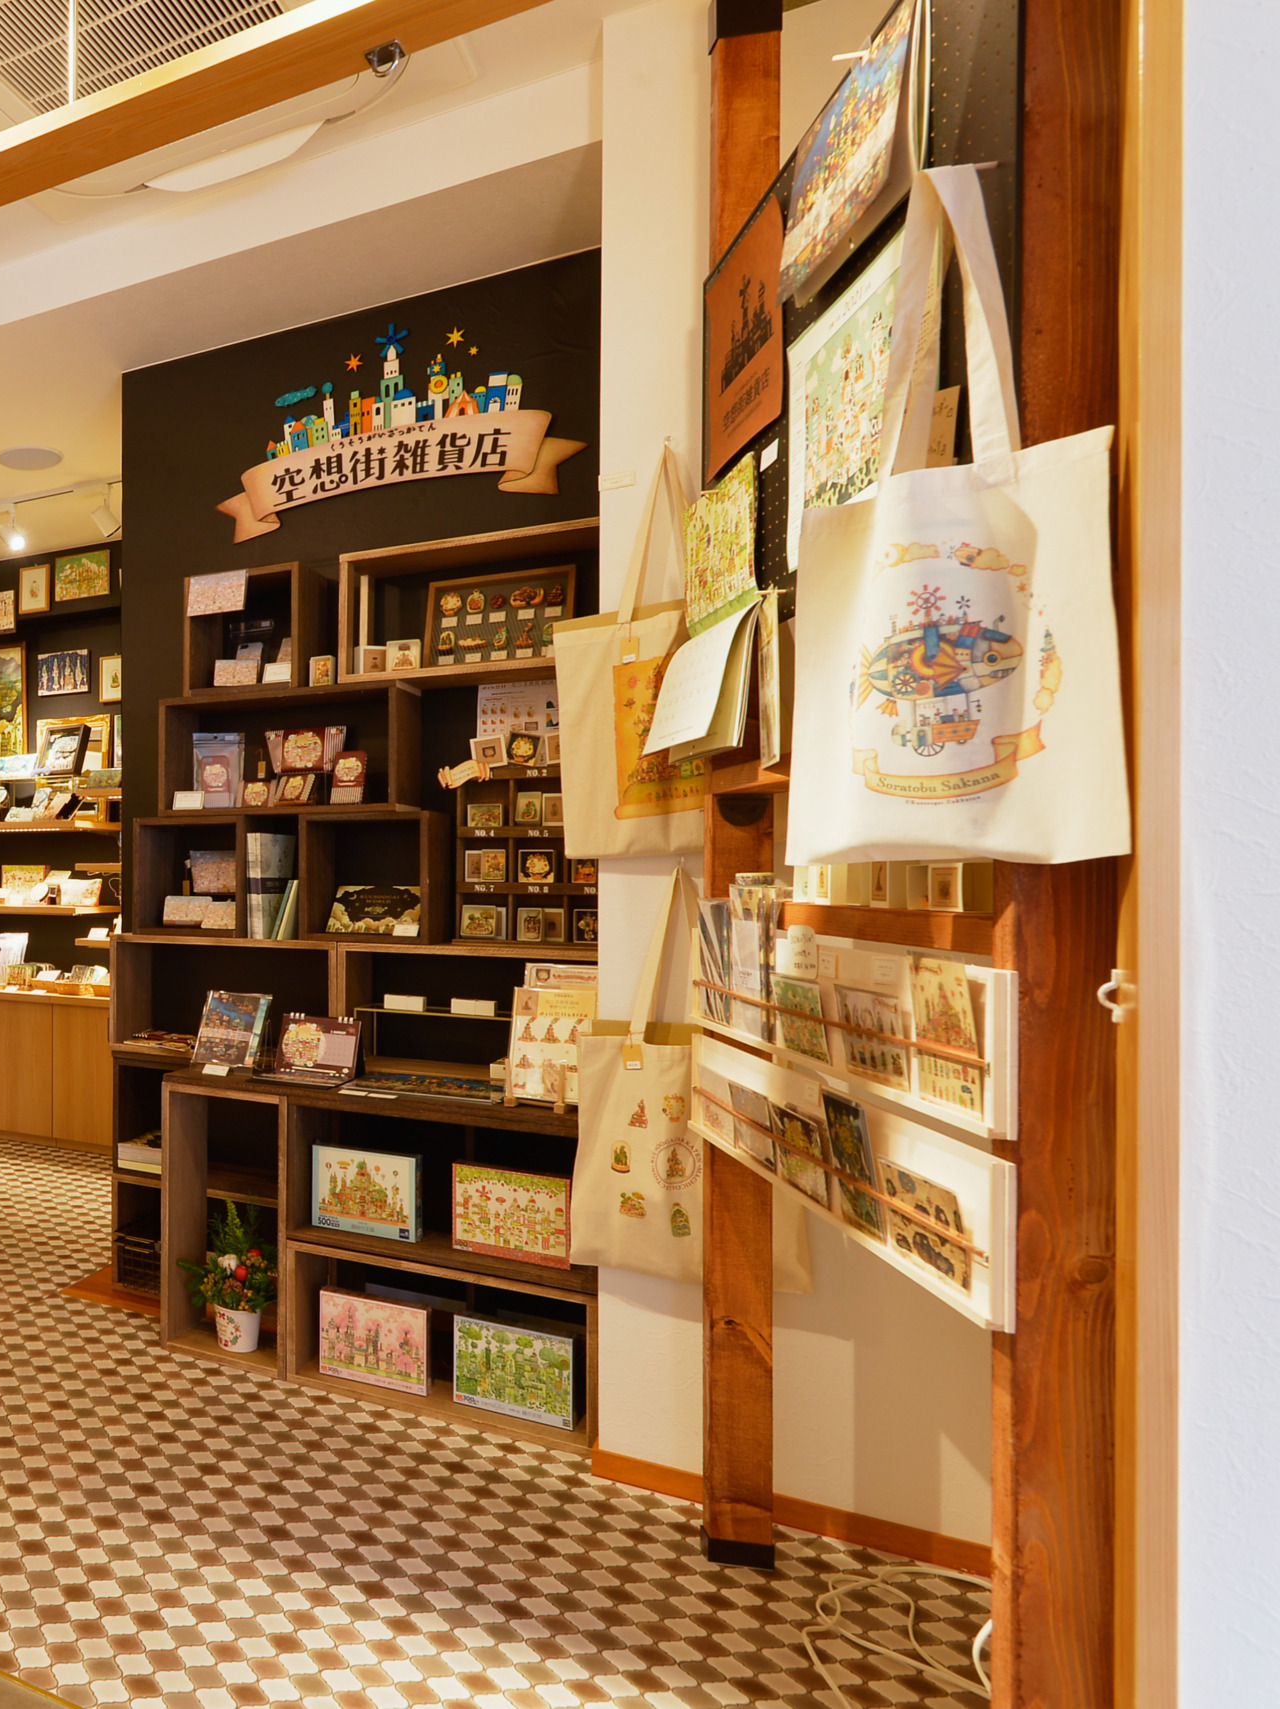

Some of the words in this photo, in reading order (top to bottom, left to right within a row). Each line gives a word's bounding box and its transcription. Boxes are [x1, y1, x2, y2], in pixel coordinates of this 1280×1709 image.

[271, 428, 512, 507] 空想街雑貨店
[526, 769, 541, 777] NO.
[876, 777, 937, 793] Soratobu
[941, 772, 1001, 792] Sakana
[474, 829, 488, 837] NO.
[527, 829, 541, 837] NO.
[317, 1216, 331, 1227] 500
